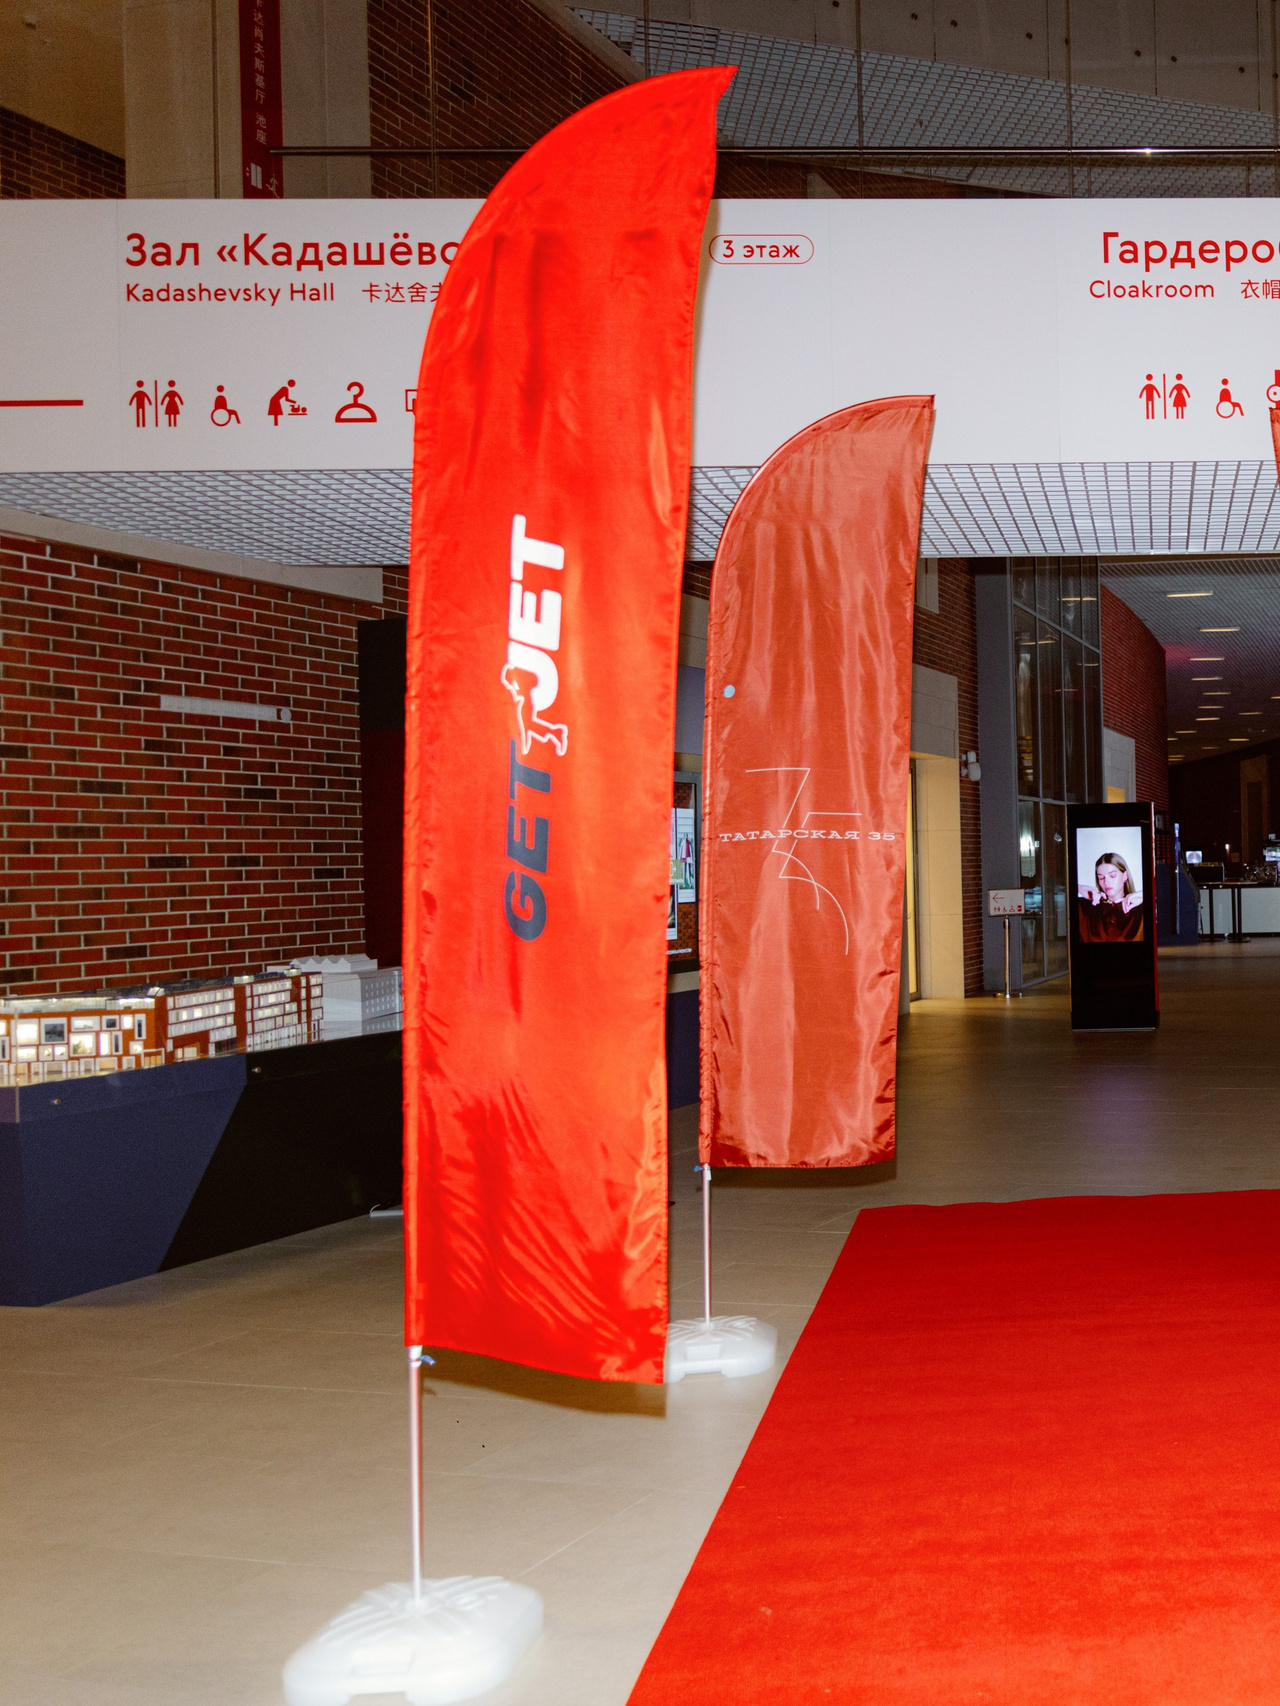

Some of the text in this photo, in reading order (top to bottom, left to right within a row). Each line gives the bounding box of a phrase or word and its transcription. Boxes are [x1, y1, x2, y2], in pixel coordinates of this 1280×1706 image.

[125, 231, 200, 267] Зал
[722, 240, 800, 258] 3 этаж
[126, 282, 281, 307] Kadashevsky
[290, 282, 334, 302] Hall
[1089, 280, 1215, 298] Cloakroom
[719, 829, 896, 842] ТАТАРСКАЯ 35
